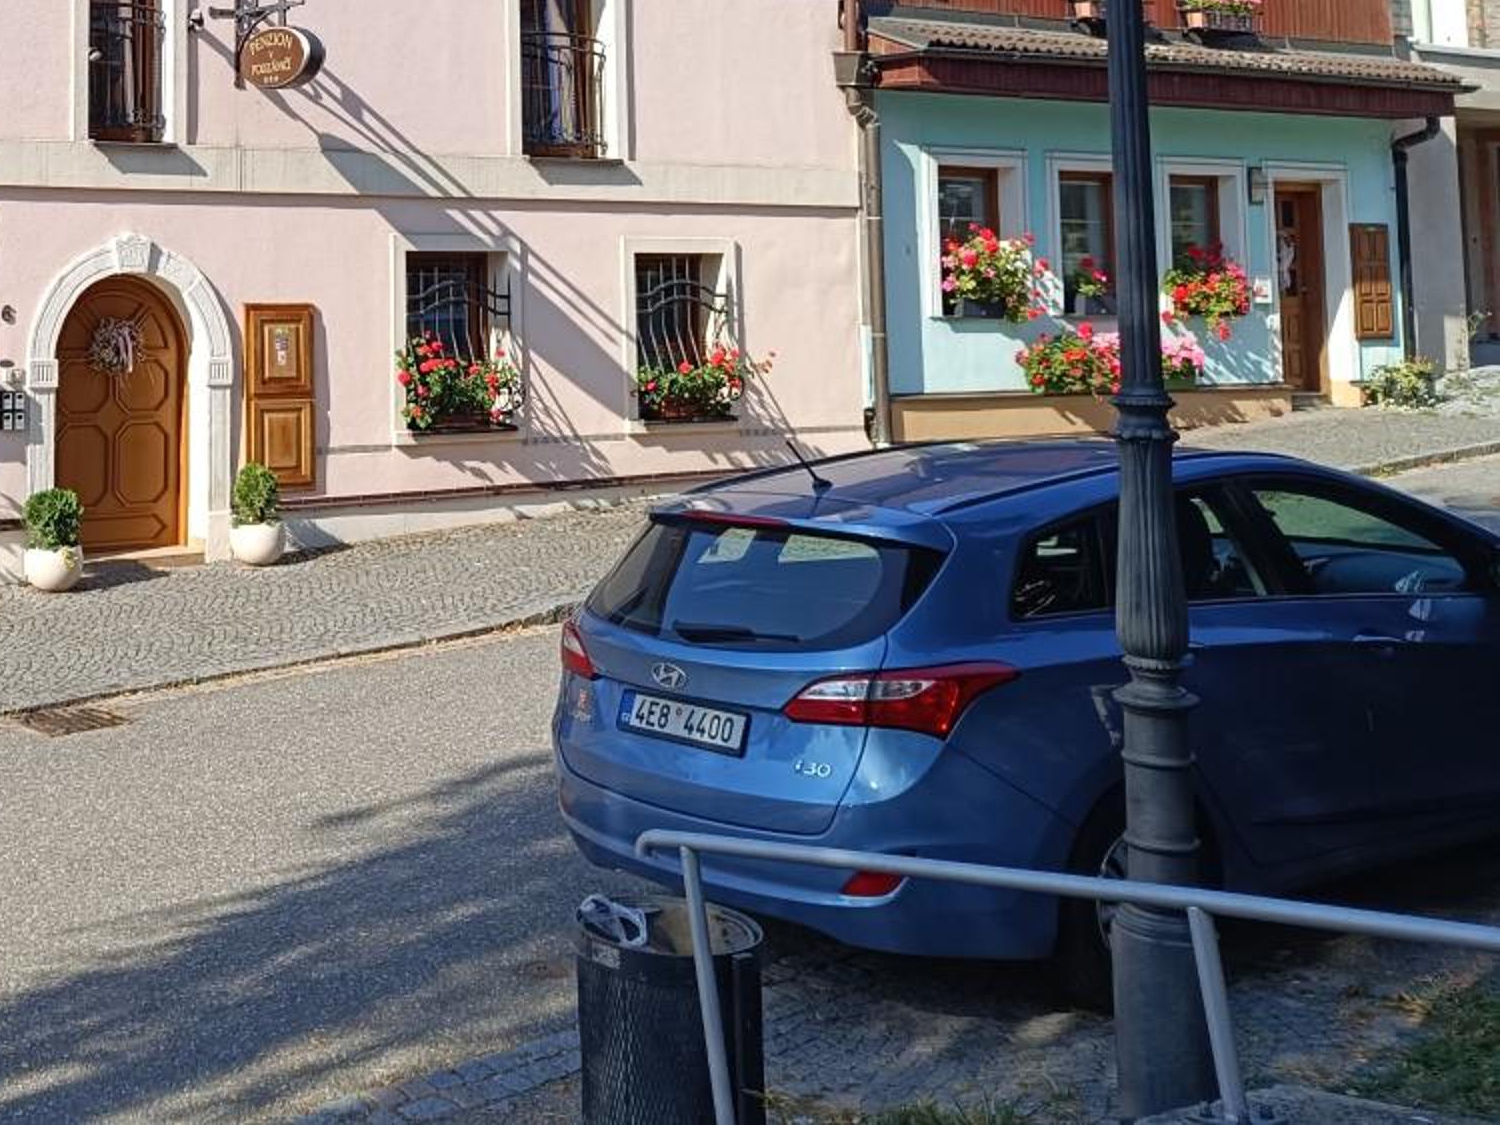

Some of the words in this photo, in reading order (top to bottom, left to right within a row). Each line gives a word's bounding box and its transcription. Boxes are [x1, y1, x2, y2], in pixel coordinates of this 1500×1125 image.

[636, 699, 670, 729] 4E8
[685, 709, 734, 742] 4400
[795, 759, 831, 778] i30
